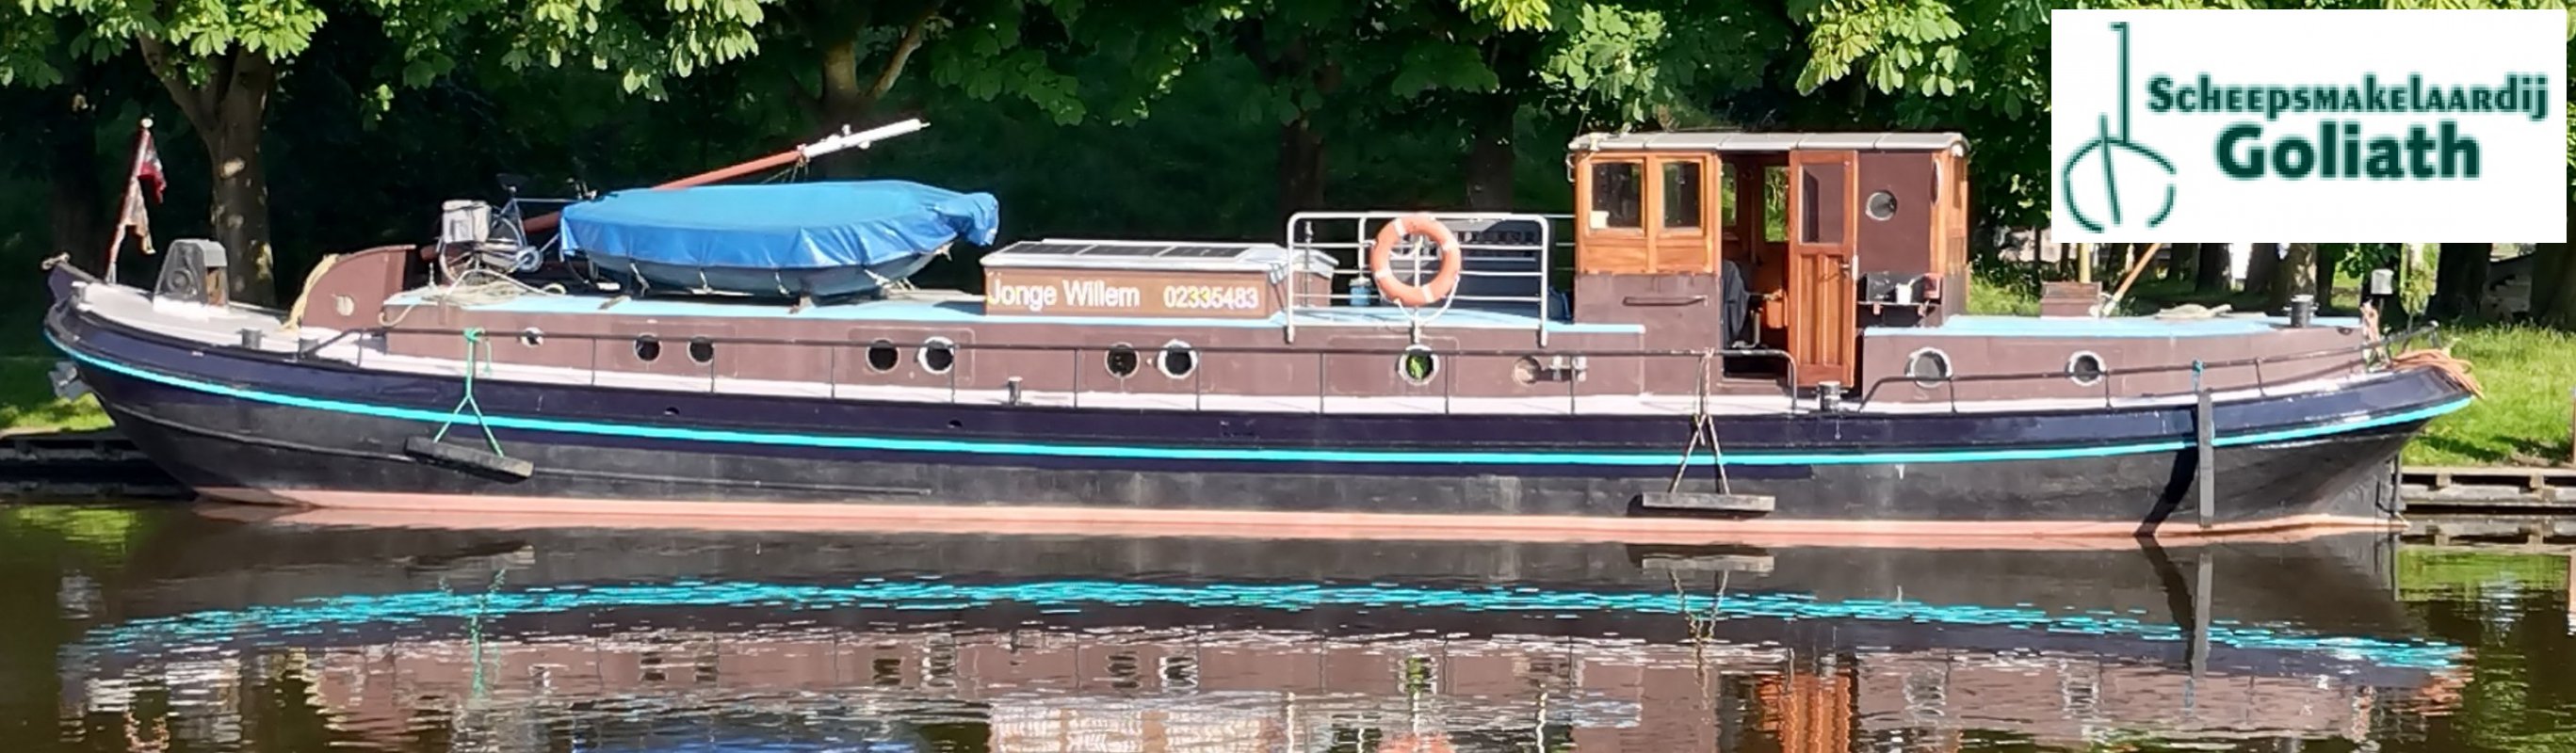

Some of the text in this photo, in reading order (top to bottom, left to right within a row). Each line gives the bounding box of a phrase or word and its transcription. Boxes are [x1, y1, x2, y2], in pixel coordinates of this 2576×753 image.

[986, 278, 1259, 312] Jonge Willem 02335483
